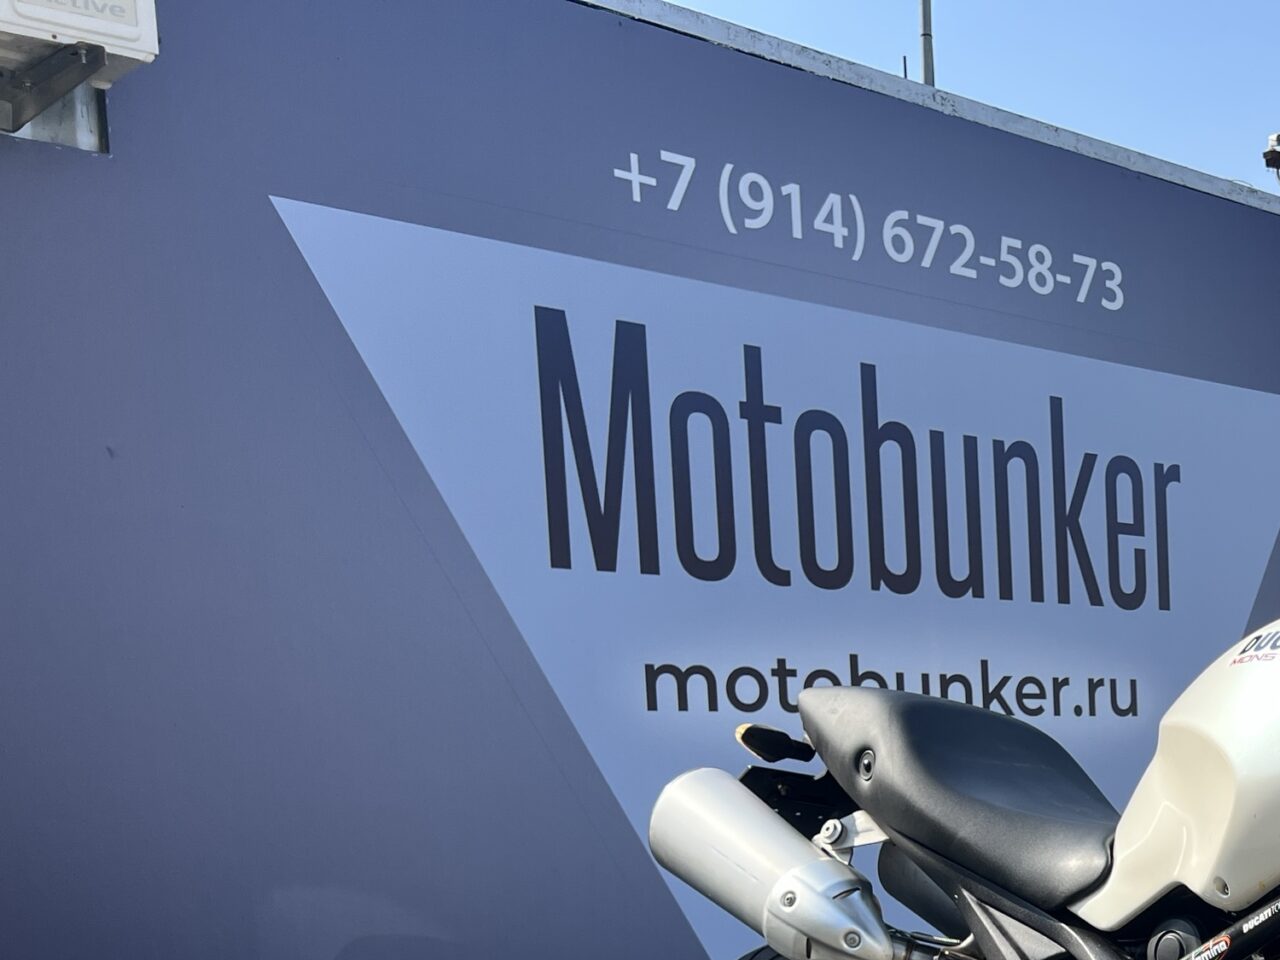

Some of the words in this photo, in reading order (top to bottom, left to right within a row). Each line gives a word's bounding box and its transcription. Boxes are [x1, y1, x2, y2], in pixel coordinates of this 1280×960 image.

[613, 149, 697, 211] +7
[718, 162, 866, 262] (914)
[882, 209, 1125, 311] 672-58-73
[533, 304, 1182, 612] Motobunker
